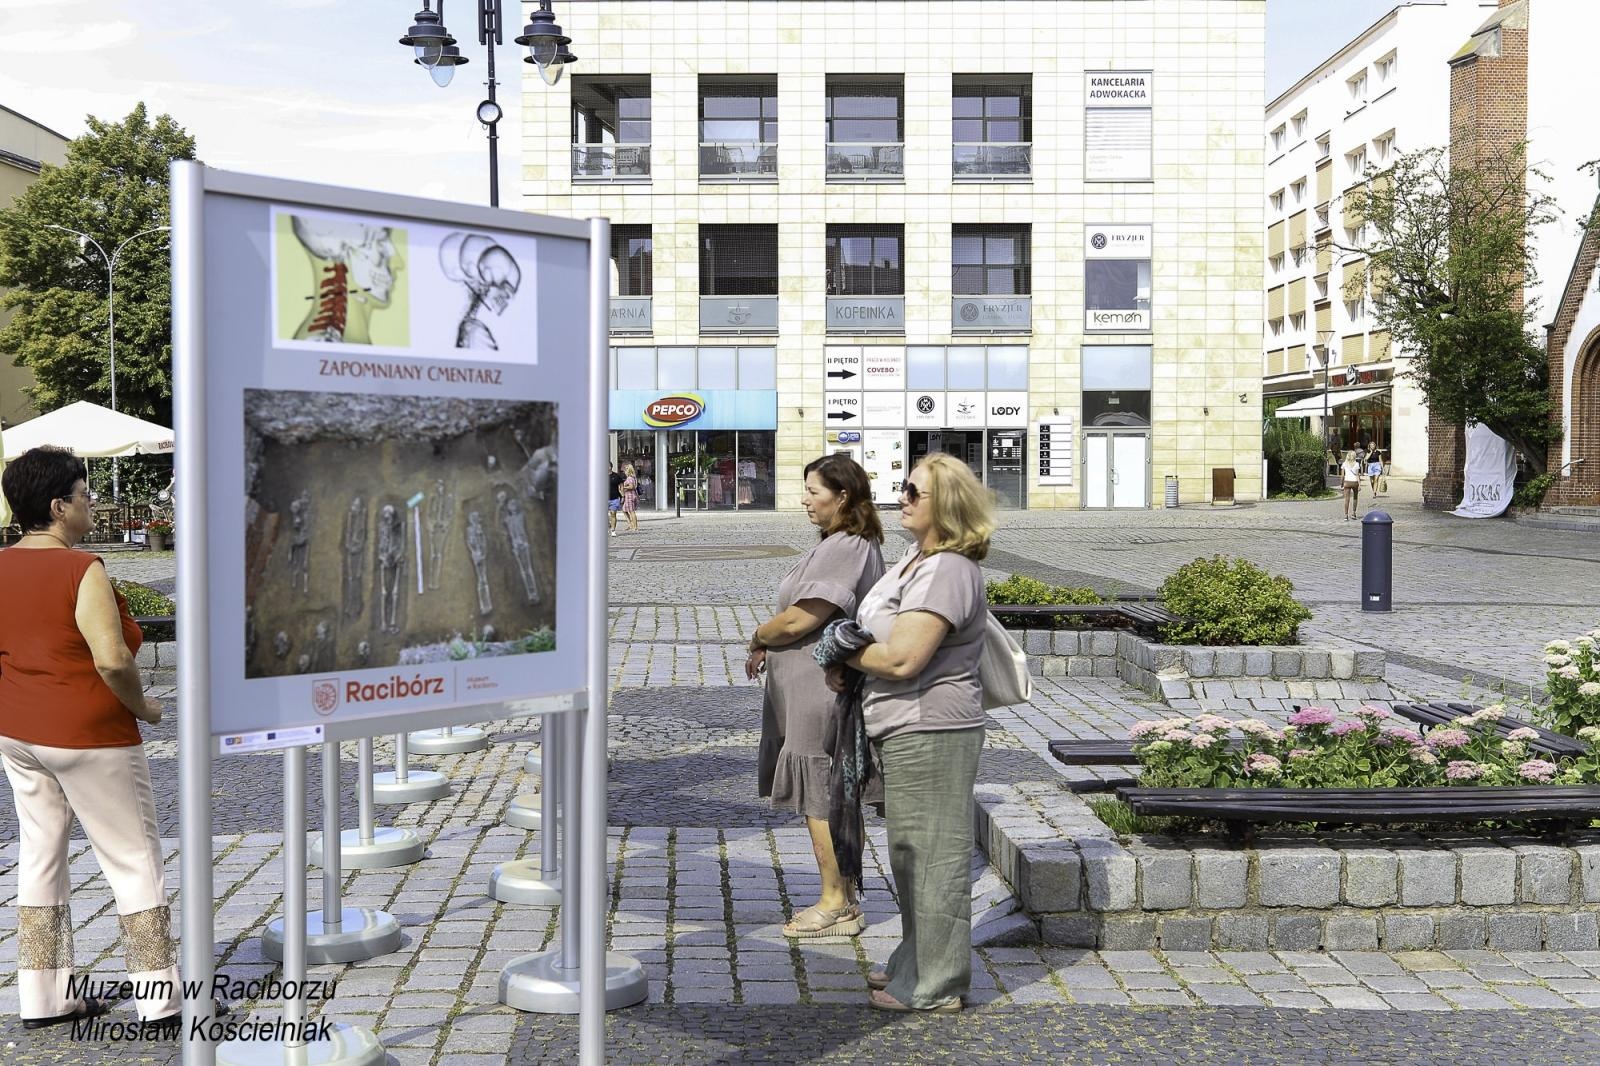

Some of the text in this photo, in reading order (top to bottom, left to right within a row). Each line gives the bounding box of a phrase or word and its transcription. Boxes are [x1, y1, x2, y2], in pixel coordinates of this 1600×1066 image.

[1091, 78, 1145, 86] KANCELARIA
[1090, 90, 1146, 98] ADWOKACKA
[610, 307, 646, 319] ARNIA
[836, 306, 895, 319] KOFEINKA
[834, 357, 859, 365] PIĘTRO
[319, 359, 502, 384] ZAPOMNIANY CMENTARZ
[832, 398, 858, 406] PIĘTRO
[652, 404, 695, 416] PEPCO
[991, 406, 1021, 415] LODY
[346, 673, 444, 704] Racibórz
